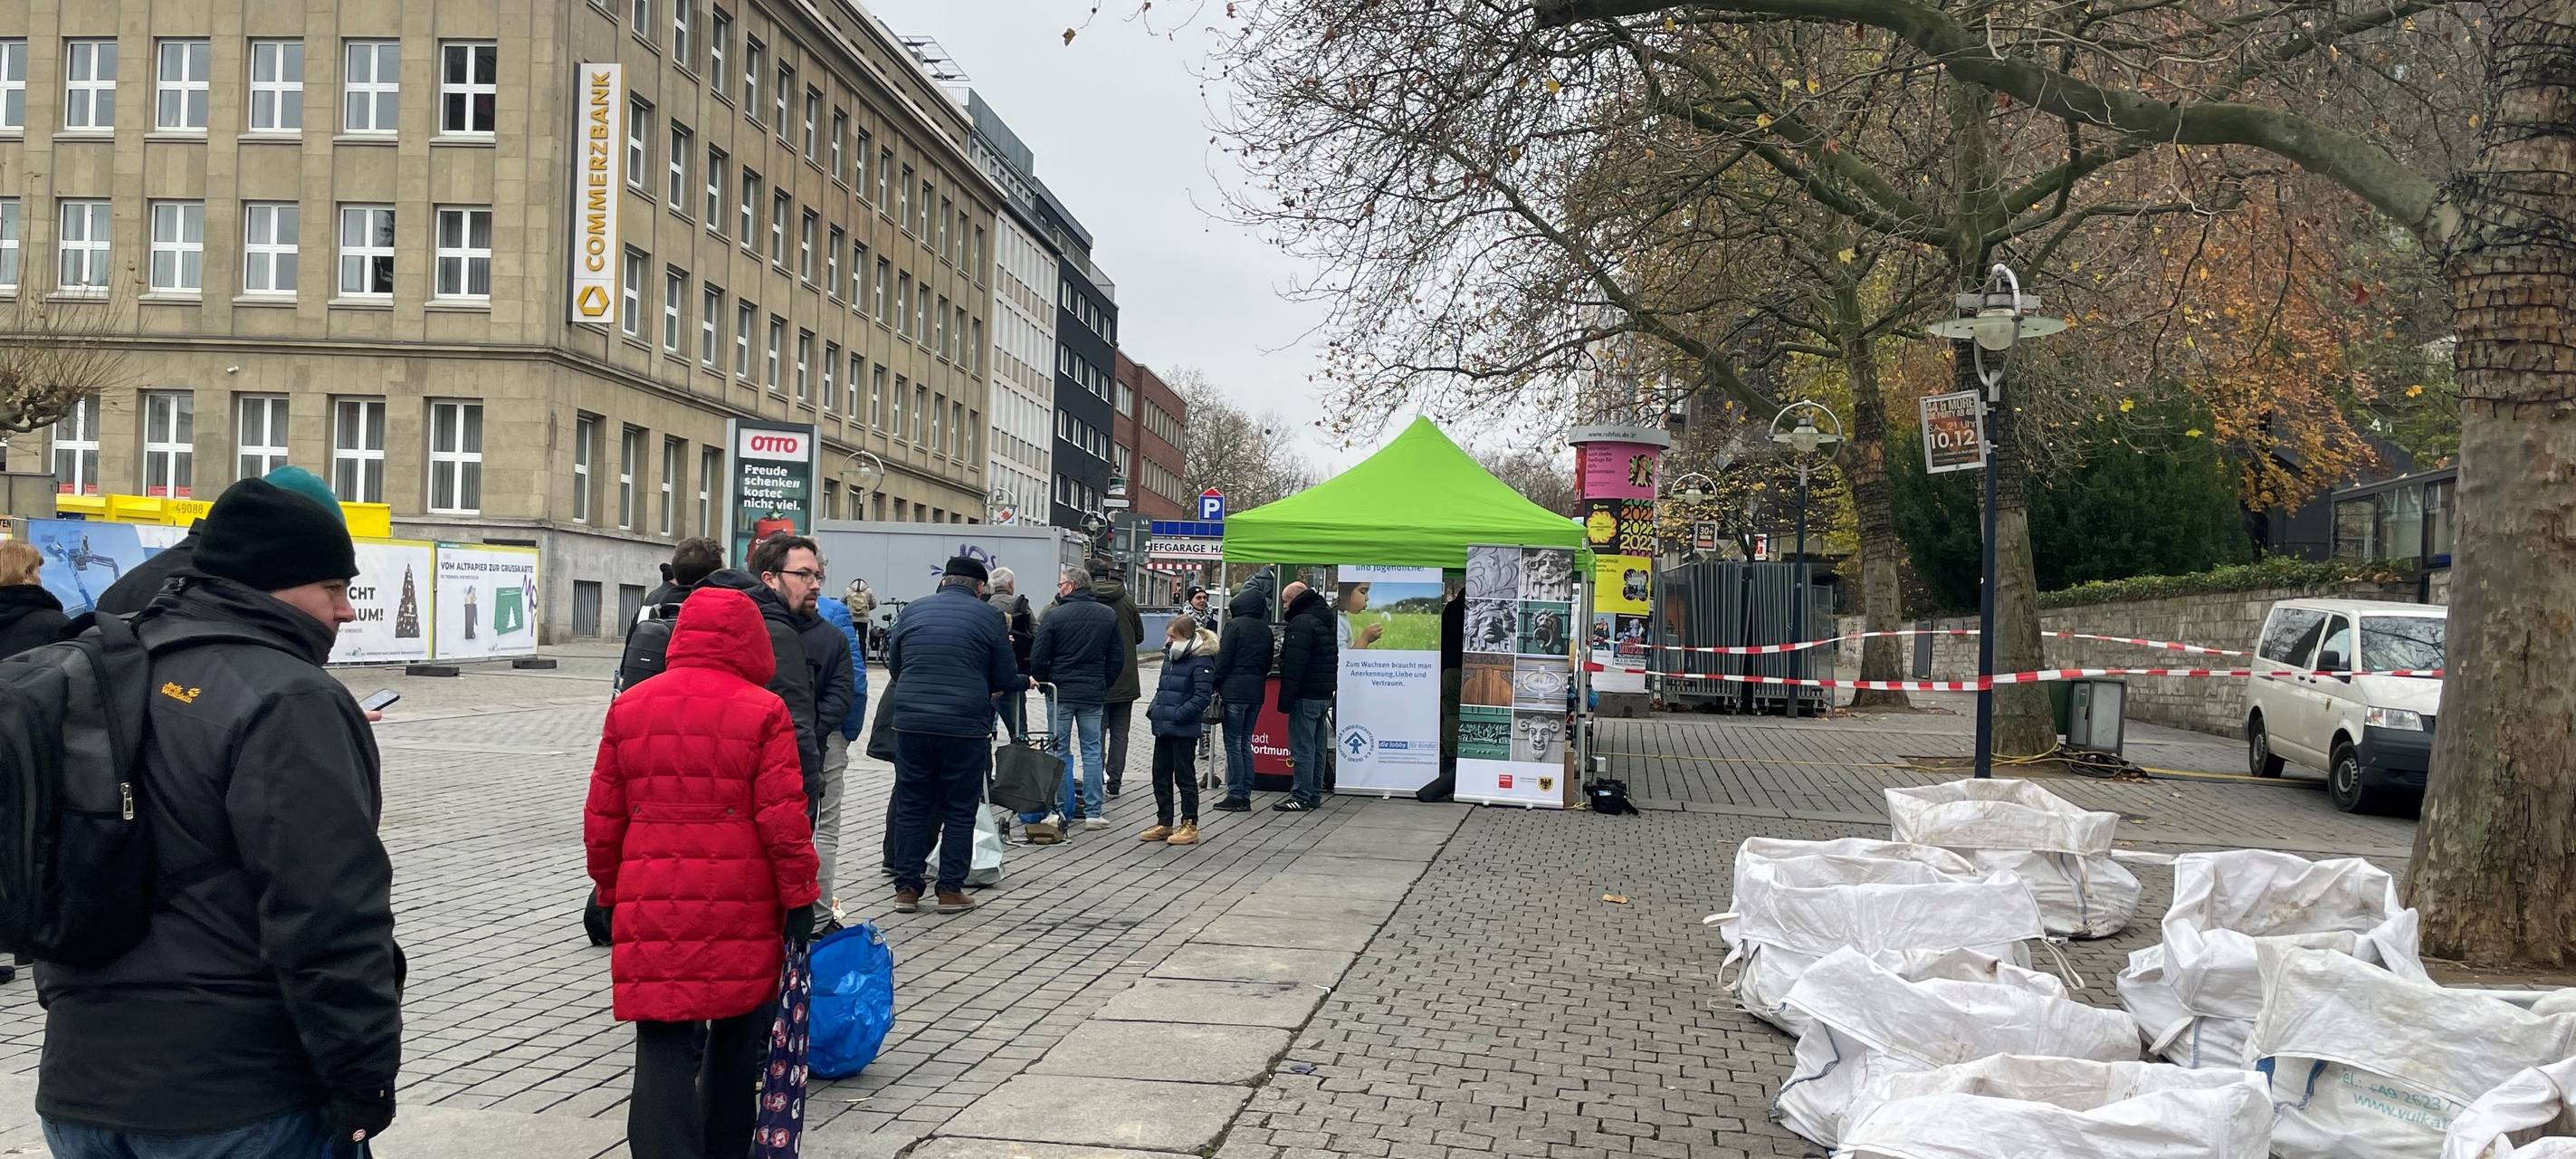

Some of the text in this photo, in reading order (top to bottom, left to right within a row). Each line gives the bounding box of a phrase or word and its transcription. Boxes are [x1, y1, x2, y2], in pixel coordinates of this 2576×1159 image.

[586, 71, 611, 273] COMMERZBANK
[1948, 398, 1975, 410] MORE
[1947, 421, 1958, 431] 21
[1960, 419, 1977, 429] Uhr
[750, 435, 798, 454] OTTO
[1929, 429, 1979, 450] 10.12.
[744, 464, 788, 477] Freude
[744, 475, 800, 489] schenken
[744, 486, 783, 499] kostet
[176, 503, 204, 514] 49088
[743, 498, 801, 511] nicht viel.
[1203, 498, 1221, 519] P
[1699, 526, 1713, 536] 30+
[1150, 543, 1224, 553] IEFGARAGE HA
[440, 561, 534, 573] VOM ALTPAPIER ZUR GRUSSKARTE
[348, 587, 376, 599] CHT
[354, 608, 383, 621] AUM!
[1345, 660, 1360, 668] Zum
[1391, 661, 1417, 669] braucht
[1371, 679, 1406, 687] Vertrauen.
[1252, 733, 1269, 743] tadt
[1251, 744, 1292, 756] ortmun
[1389, 741, 1407, 749] lobby
[2342, 1070, 2362, 1088] el.:
[2368, 1084, 2398, 1099] +49
[2401, 1090, 2441, 1111] 2623
[2353, 1093, 2453, 1130] www.vulkat
